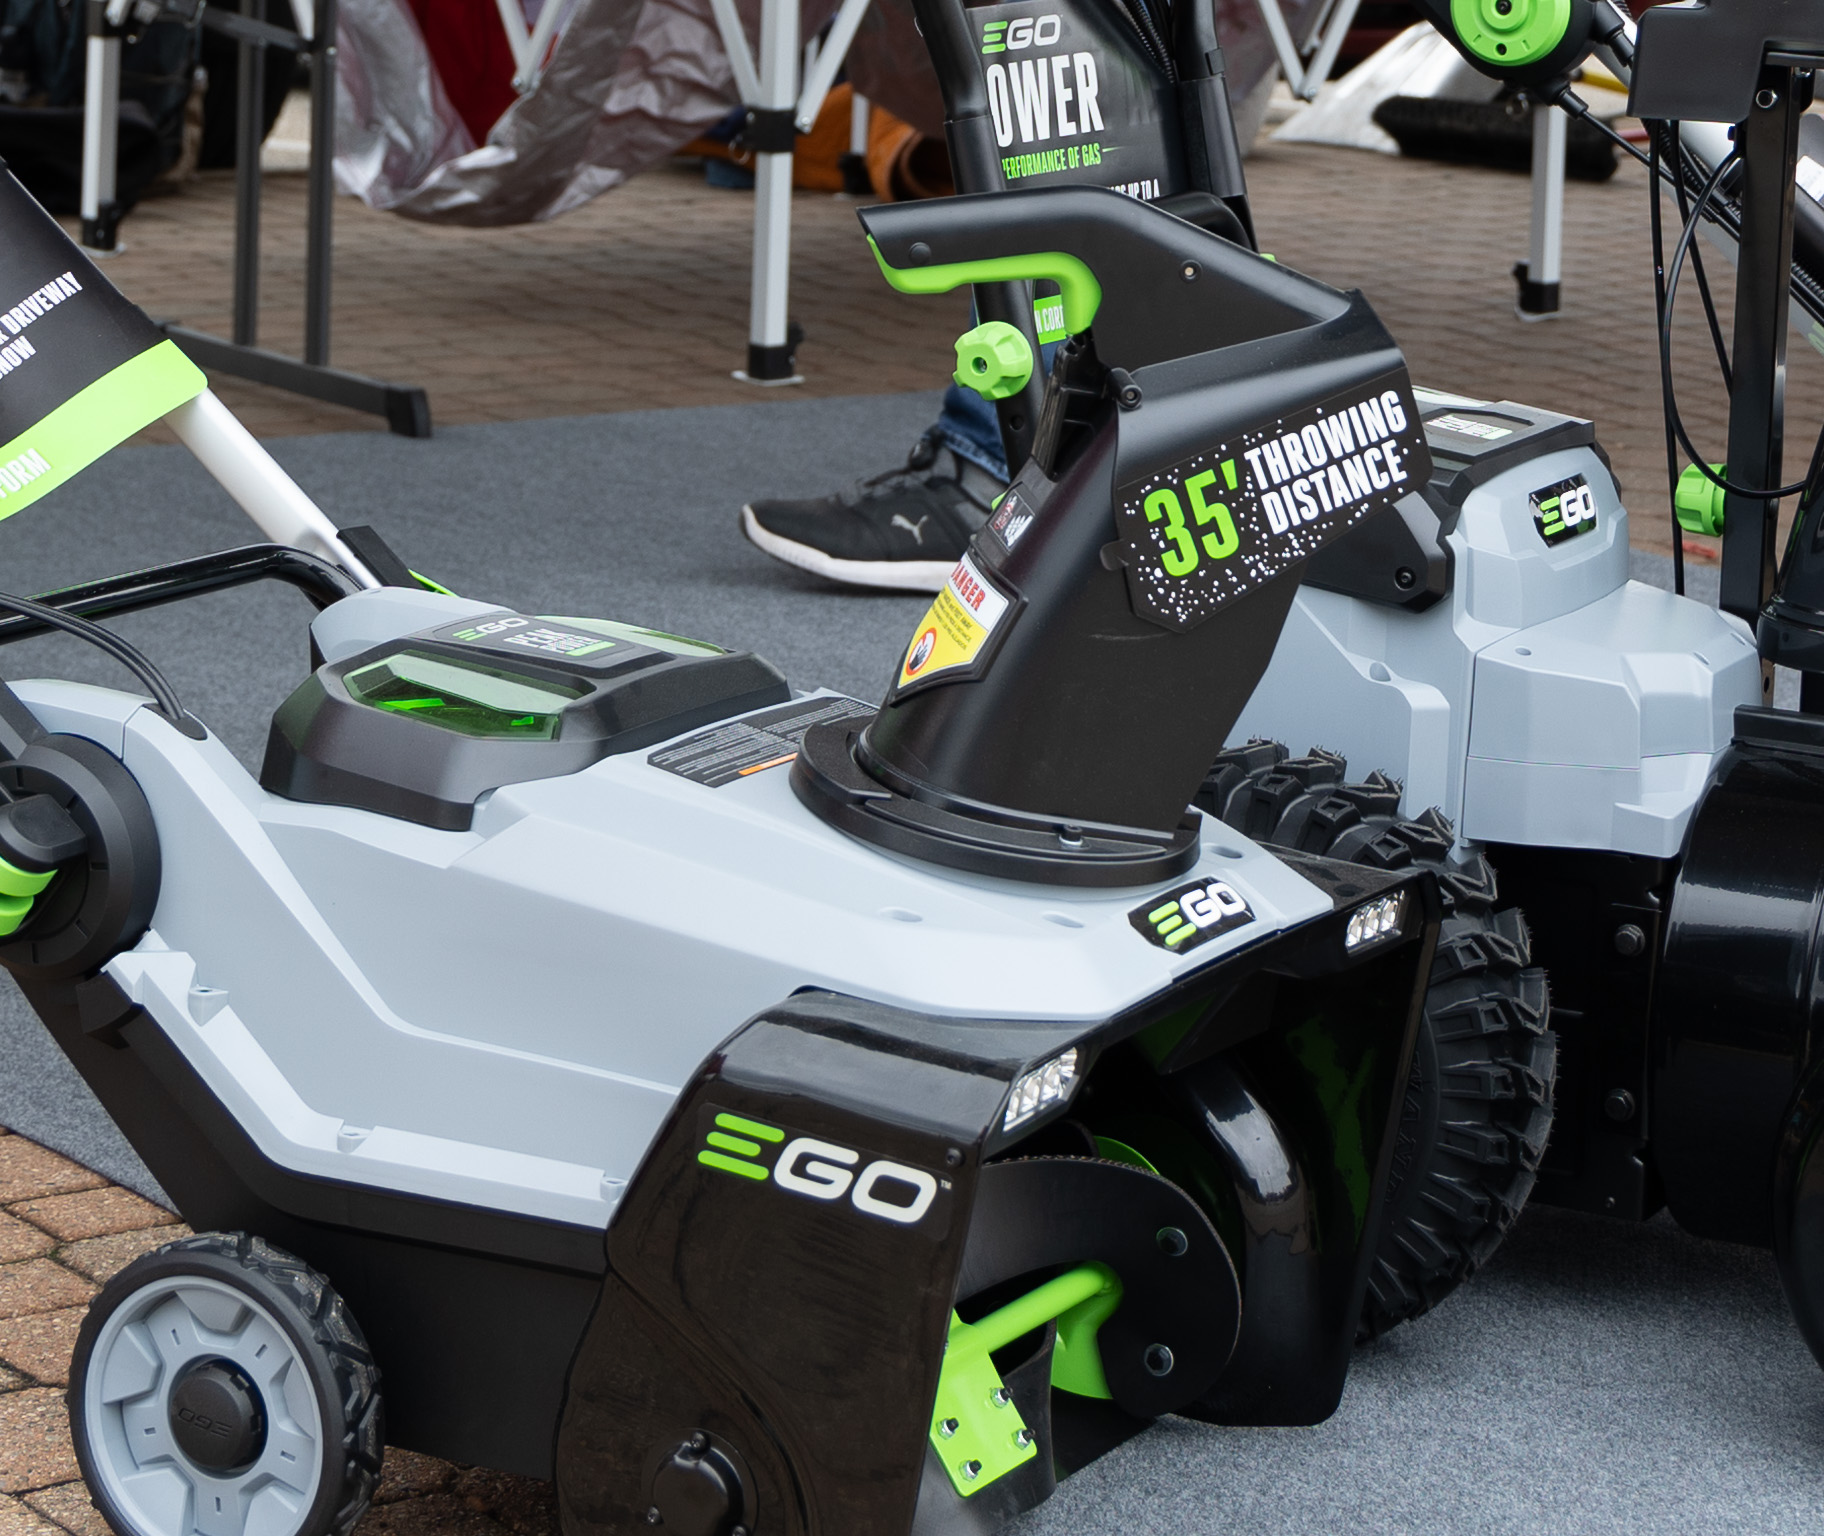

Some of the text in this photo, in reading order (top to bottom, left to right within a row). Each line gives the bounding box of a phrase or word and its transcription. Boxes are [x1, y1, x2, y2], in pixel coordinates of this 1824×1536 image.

[982, 14, 1061, 54] EGO
[986, 52, 1105, 148] OWER
[1067, 146, 1080, 168] OF
[1082, 143, 1101, 166] GAS
[0, 271, 83, 335] DRIVEWAY
[1244, 389, 1408, 491] THROWING
[1143, 459, 1239, 578] 35'
[1259, 439, 1409, 537] DISTANCE
[1540, 484, 1596, 536] EGO
[452, 617, 529, 641] EGO
[1147, 880, 1247, 947] EGO
[697, 1112, 939, 1224] EGO
